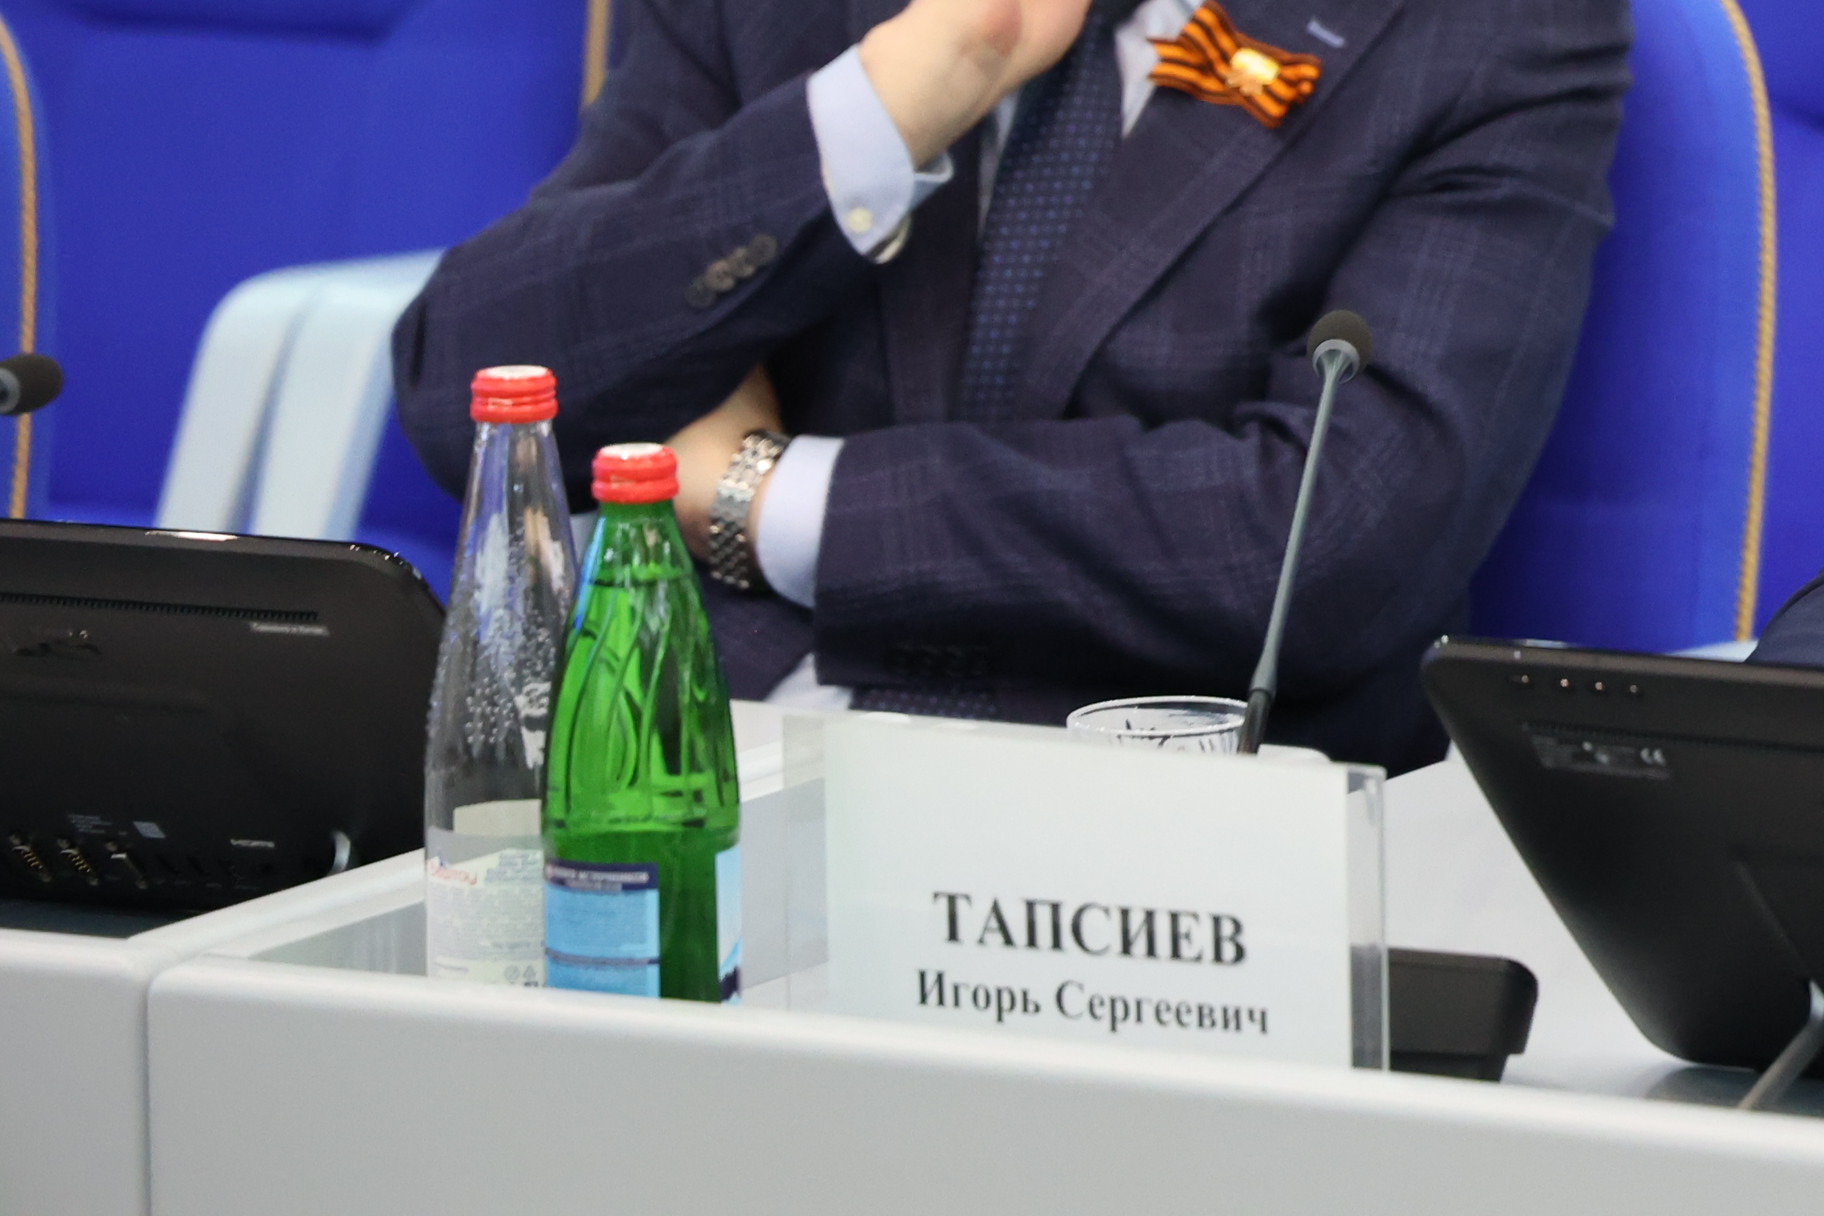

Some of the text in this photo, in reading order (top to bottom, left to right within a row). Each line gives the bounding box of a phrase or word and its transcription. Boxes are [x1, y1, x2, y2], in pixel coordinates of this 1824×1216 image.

[932, 891, 1247, 966] ТАПСИЕВ
[917, 968, 1270, 1035] Игорь Сергеевич
